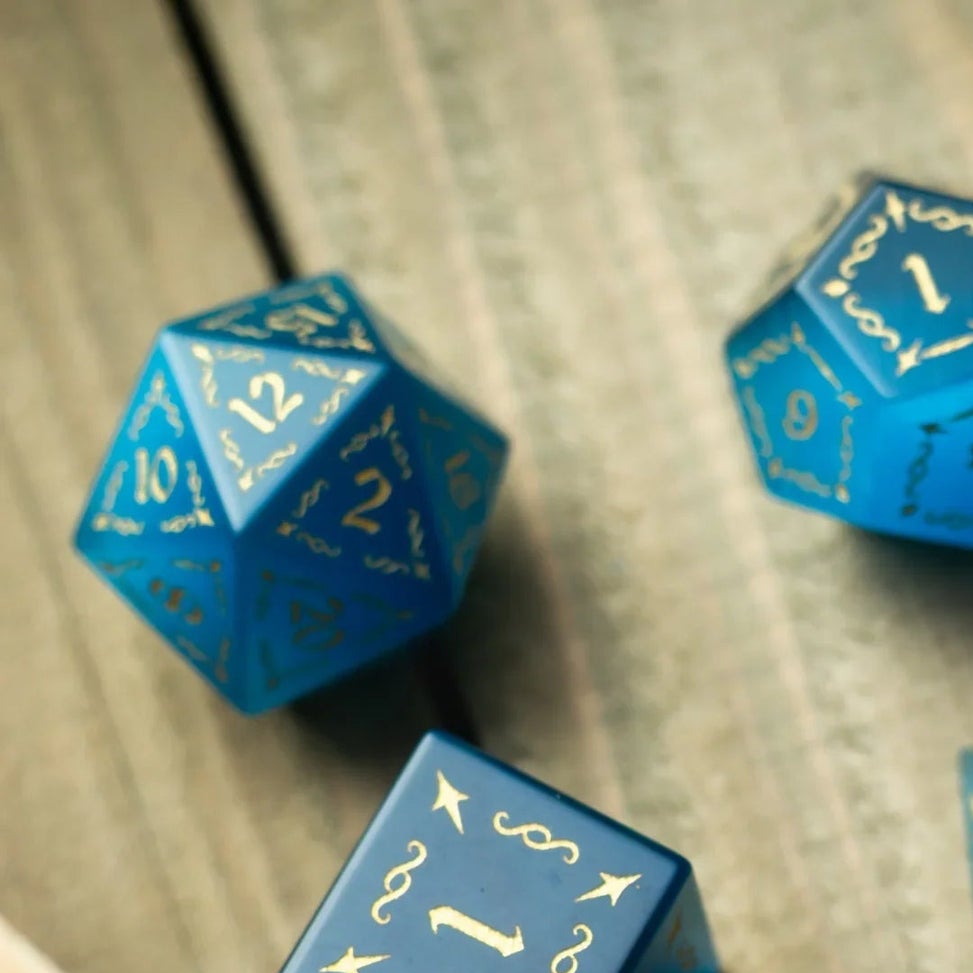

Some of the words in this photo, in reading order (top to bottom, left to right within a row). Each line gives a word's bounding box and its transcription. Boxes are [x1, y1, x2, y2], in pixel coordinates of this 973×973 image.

[903, 253, 950, 315] 1
[228, 371, 304, 434] 12
[135, 446, 179, 504] 10
[341, 467, 393, 535] 2
[428, 904, 525, 958] 1
